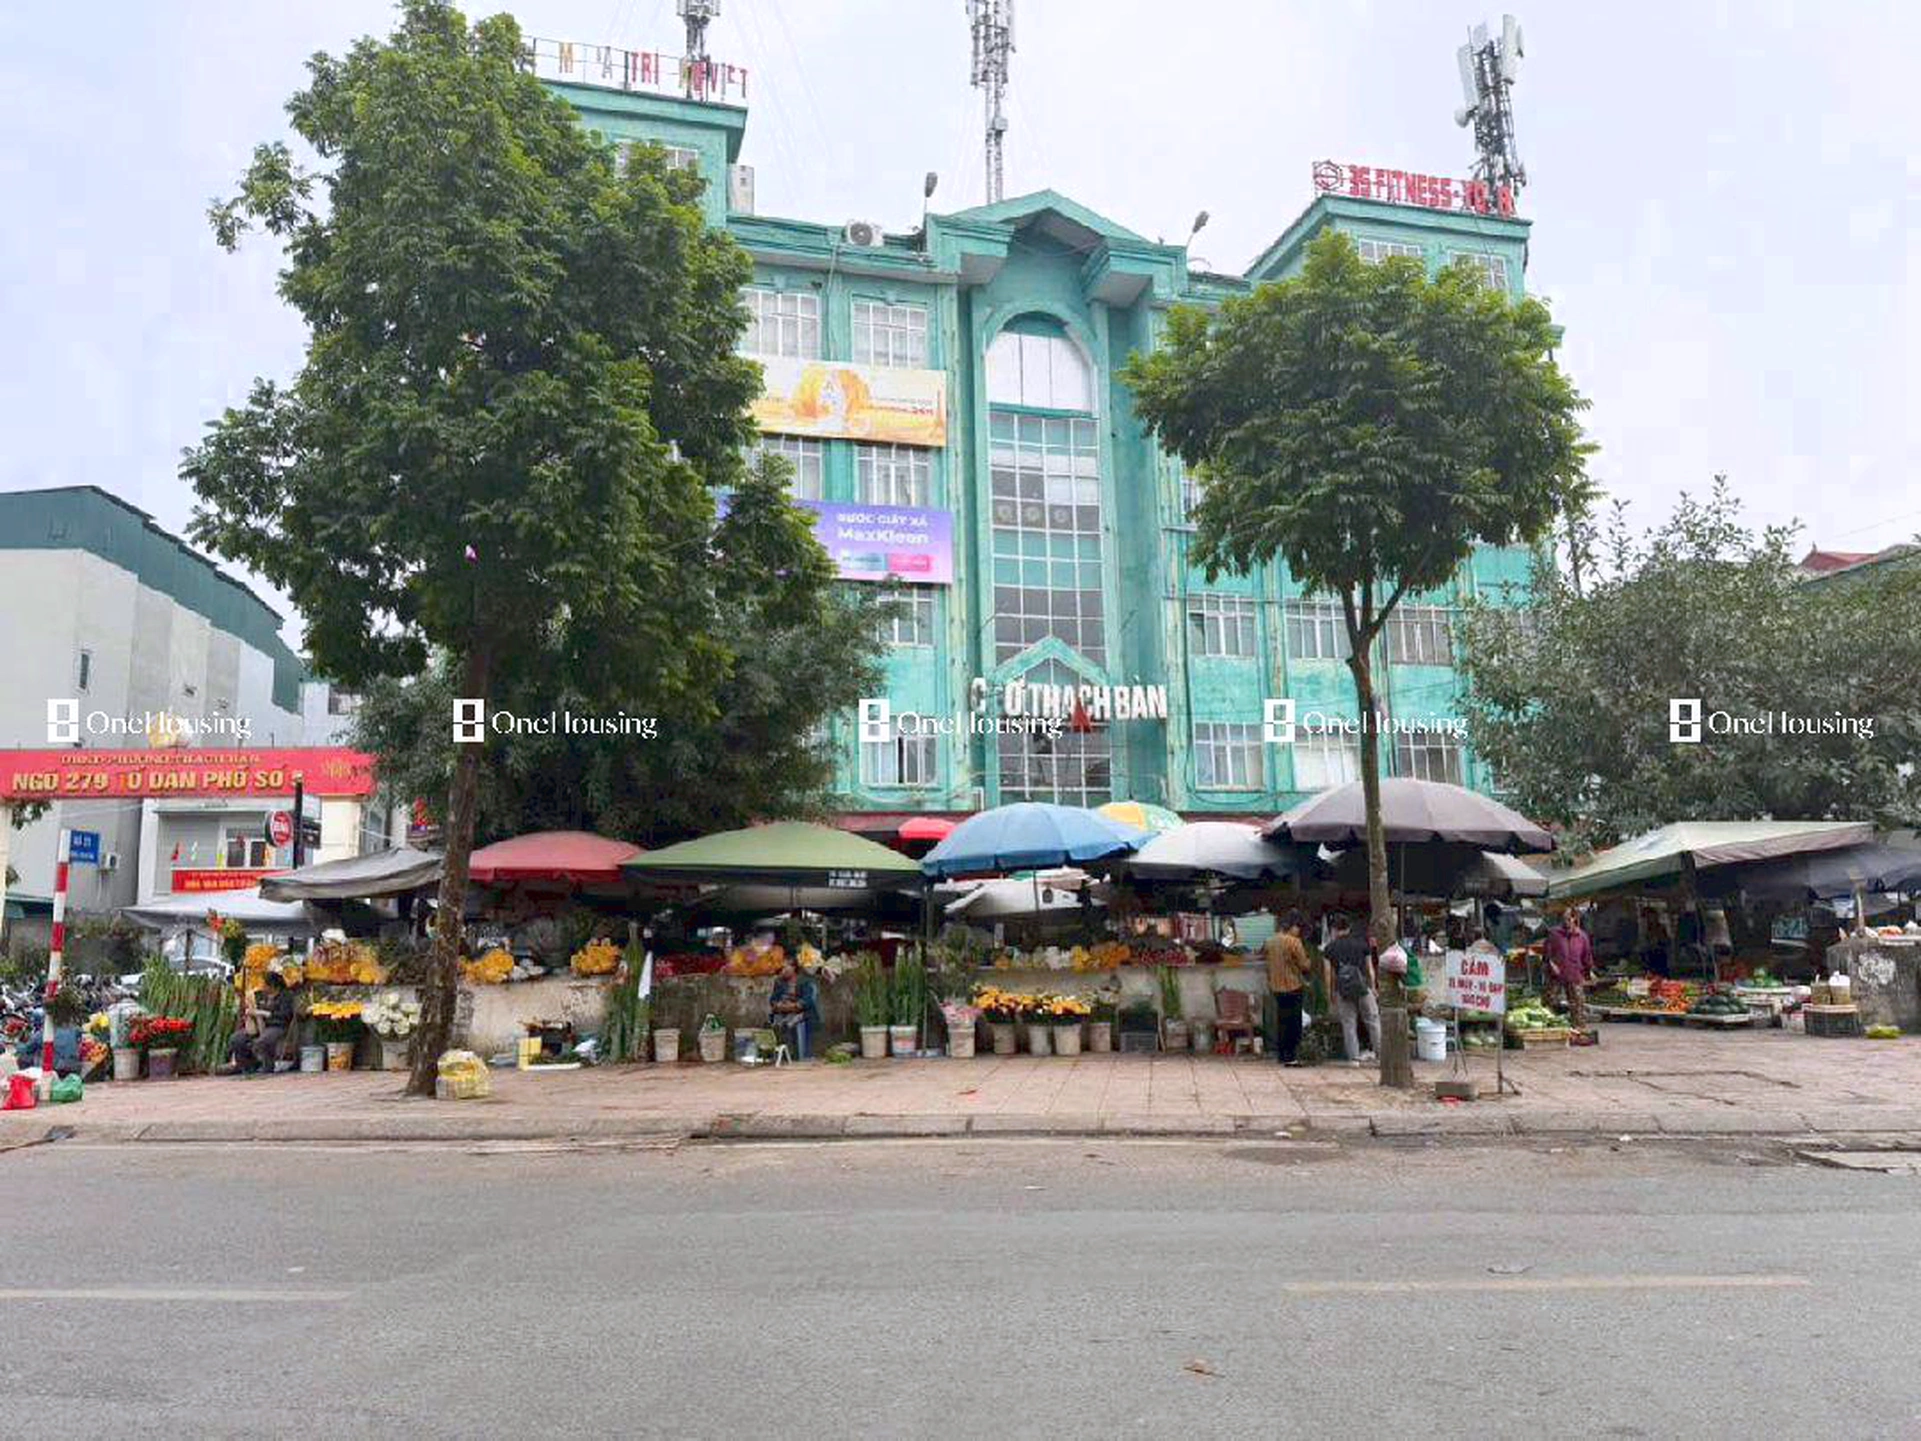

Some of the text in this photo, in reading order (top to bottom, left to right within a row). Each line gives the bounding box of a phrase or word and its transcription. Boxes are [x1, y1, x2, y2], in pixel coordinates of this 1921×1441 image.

[1375, 168, 1452, 209] FITNESS
[1114, 674, 1168, 720] BÀN
[66, 772, 110, 792] 279
